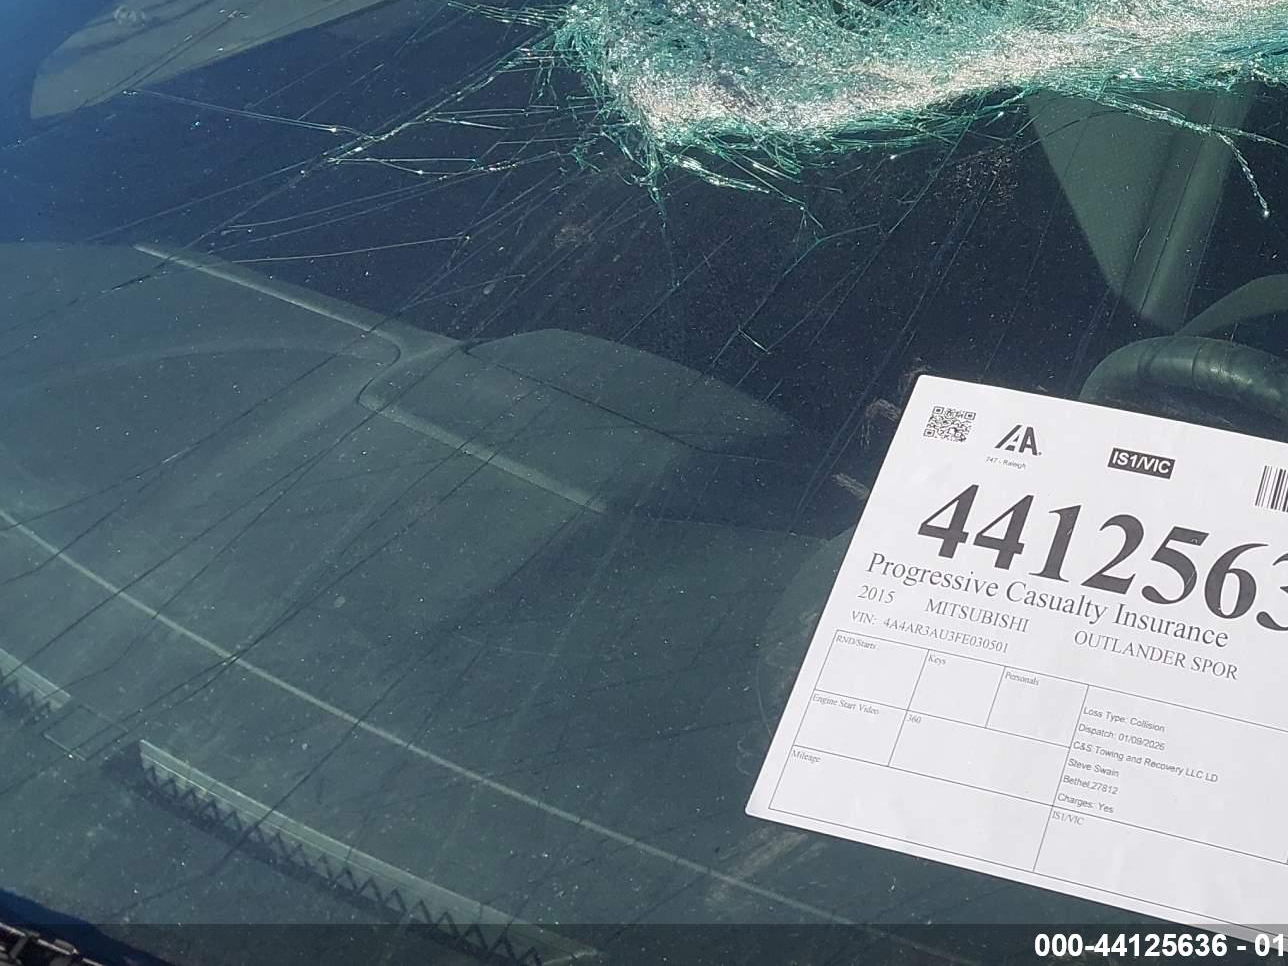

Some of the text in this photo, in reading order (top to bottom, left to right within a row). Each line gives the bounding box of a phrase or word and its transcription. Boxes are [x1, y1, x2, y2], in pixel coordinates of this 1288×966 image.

[1112, 451, 1171, 474] IS1/VIC
[857, 585, 1031, 633] 2015 MITSUBISHI
[866, 552, 1229, 648] Progressive Casualty Insurance
[852, 611, 877, 626] VIN:
[928, 654, 947, 666] Keys
[1074, 630, 1239, 681] OUTLANDER SPOR
[1004, 671, 1040, 686] Personals
[813, 694, 880, 716] Engine Start Video
[907, 714, 922, 725] 360
[1083, 707, 1166, 733] Loss Type: Collision
[1078, 724, 1115, 740] Dispatch:
[791, 749, 822, 764] Mileage
[1073, 741, 1093, 753] C&S
[1095, 746, 1125, 762] Towing
[1126, 755, 1143, 765] and
[1144, 758, 1185, 777] Recovery
[1068, 758, 1120, 778] Steve Swain
[1057, 792, 1115, 814] Charges: Yes
[1052, 810, 1085, 826] IS1/VIC
